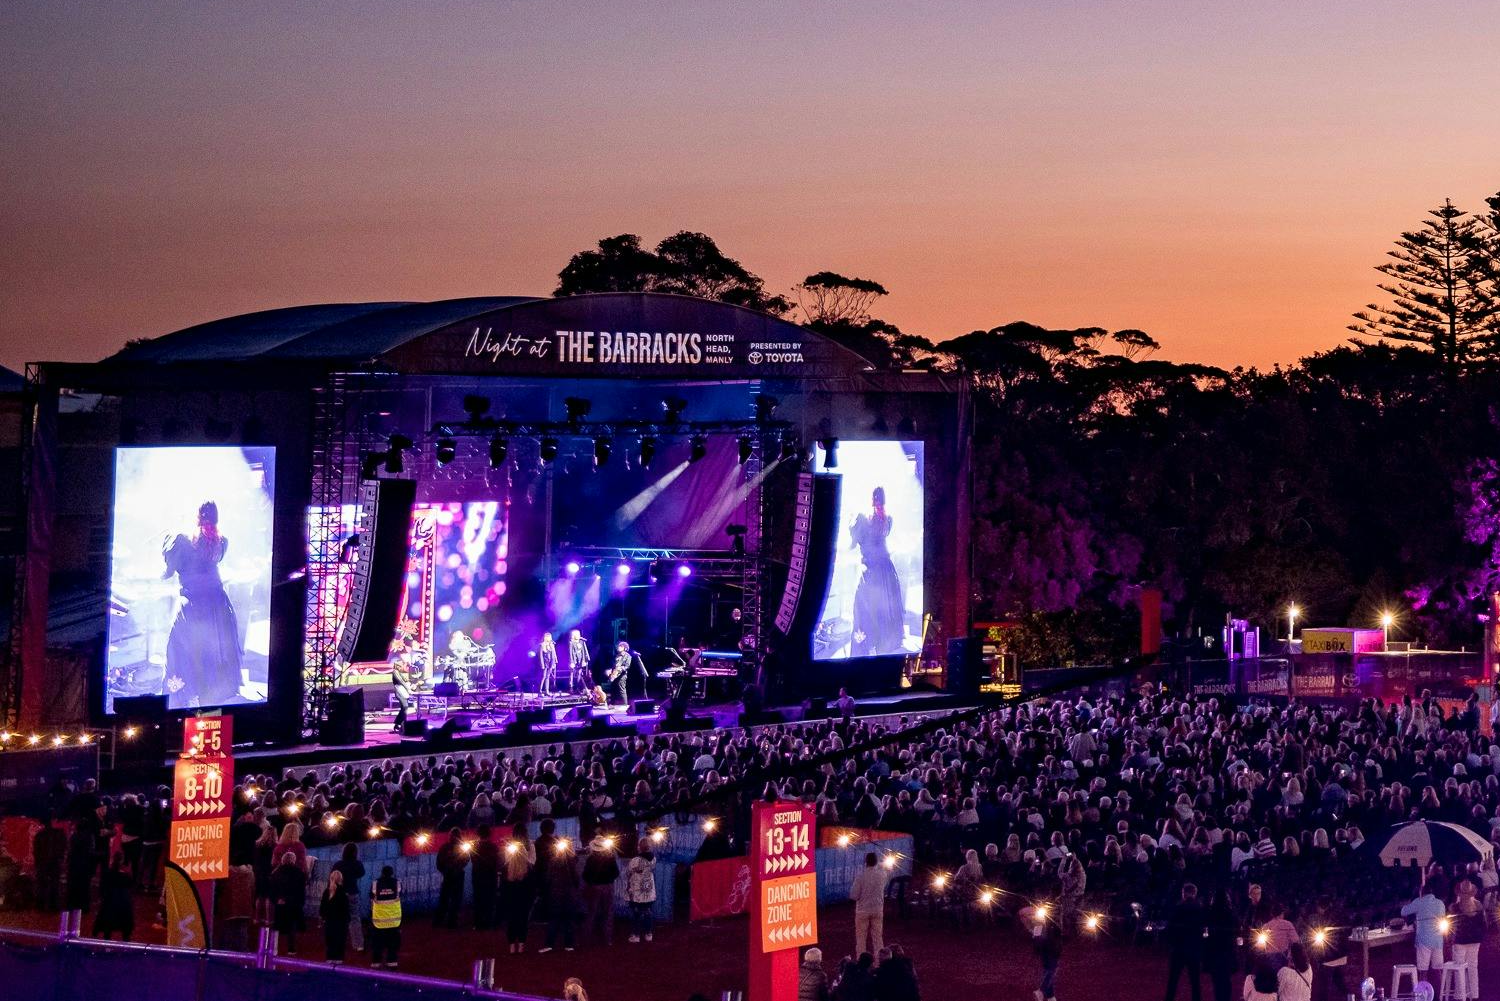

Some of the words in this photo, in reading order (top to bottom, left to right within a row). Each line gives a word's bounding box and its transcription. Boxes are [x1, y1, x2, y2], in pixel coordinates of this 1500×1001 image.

[465, 327, 531, 363] Night
[529, 334, 552, 358] at
[556, 331, 595, 363] THE
[599, 331, 702, 364] BARRACKS
[706, 334, 735, 342] NORTH
[705, 345, 731, 354] HEAD,
[750, 342, 791, 350] PRESENTED
[792, 342, 802, 350] BY
[705, 355, 734, 364] MANLY
[765, 353, 804, 363] TOYOTA
[196, 720, 222, 731] ECTION
[184, 775, 223, 800] 8-10
[774, 810, 802, 825] SECTION
[177, 824, 223, 842] DANCING
[766, 823, 810, 856] 13-14
[176, 843, 203, 859] ZONE
[767, 881, 810, 904] DANCING
[767, 904, 792, 924] ZONE
